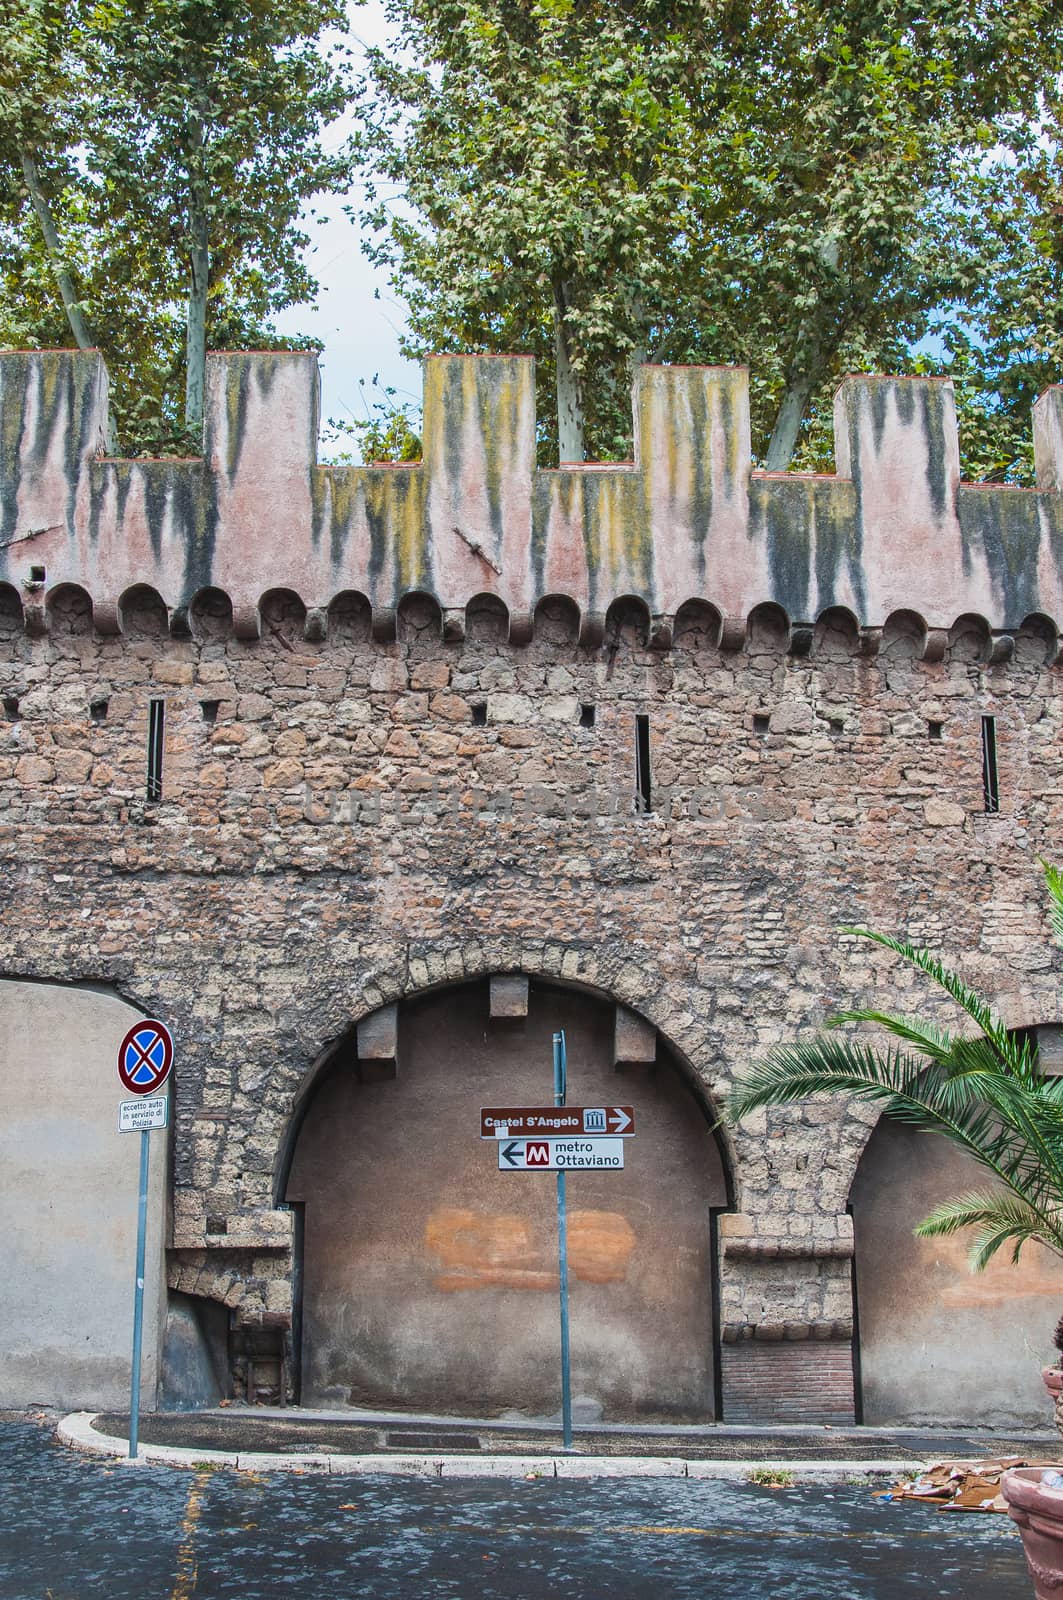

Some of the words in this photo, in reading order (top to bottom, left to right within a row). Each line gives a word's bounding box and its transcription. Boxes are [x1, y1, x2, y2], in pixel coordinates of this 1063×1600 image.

[123, 1103, 147, 1111] eccetto
[148, 1101, 163, 1109] auto
[131, 1110, 155, 1119] servizio
[132, 1119, 153, 1127] Polizia
[484, 1117, 523, 1127] Castel
[526, 1116, 579, 1128] S'Angelo
[555, 1142, 593, 1152] metro
[555, 1155, 620, 1166] Ottaviano
